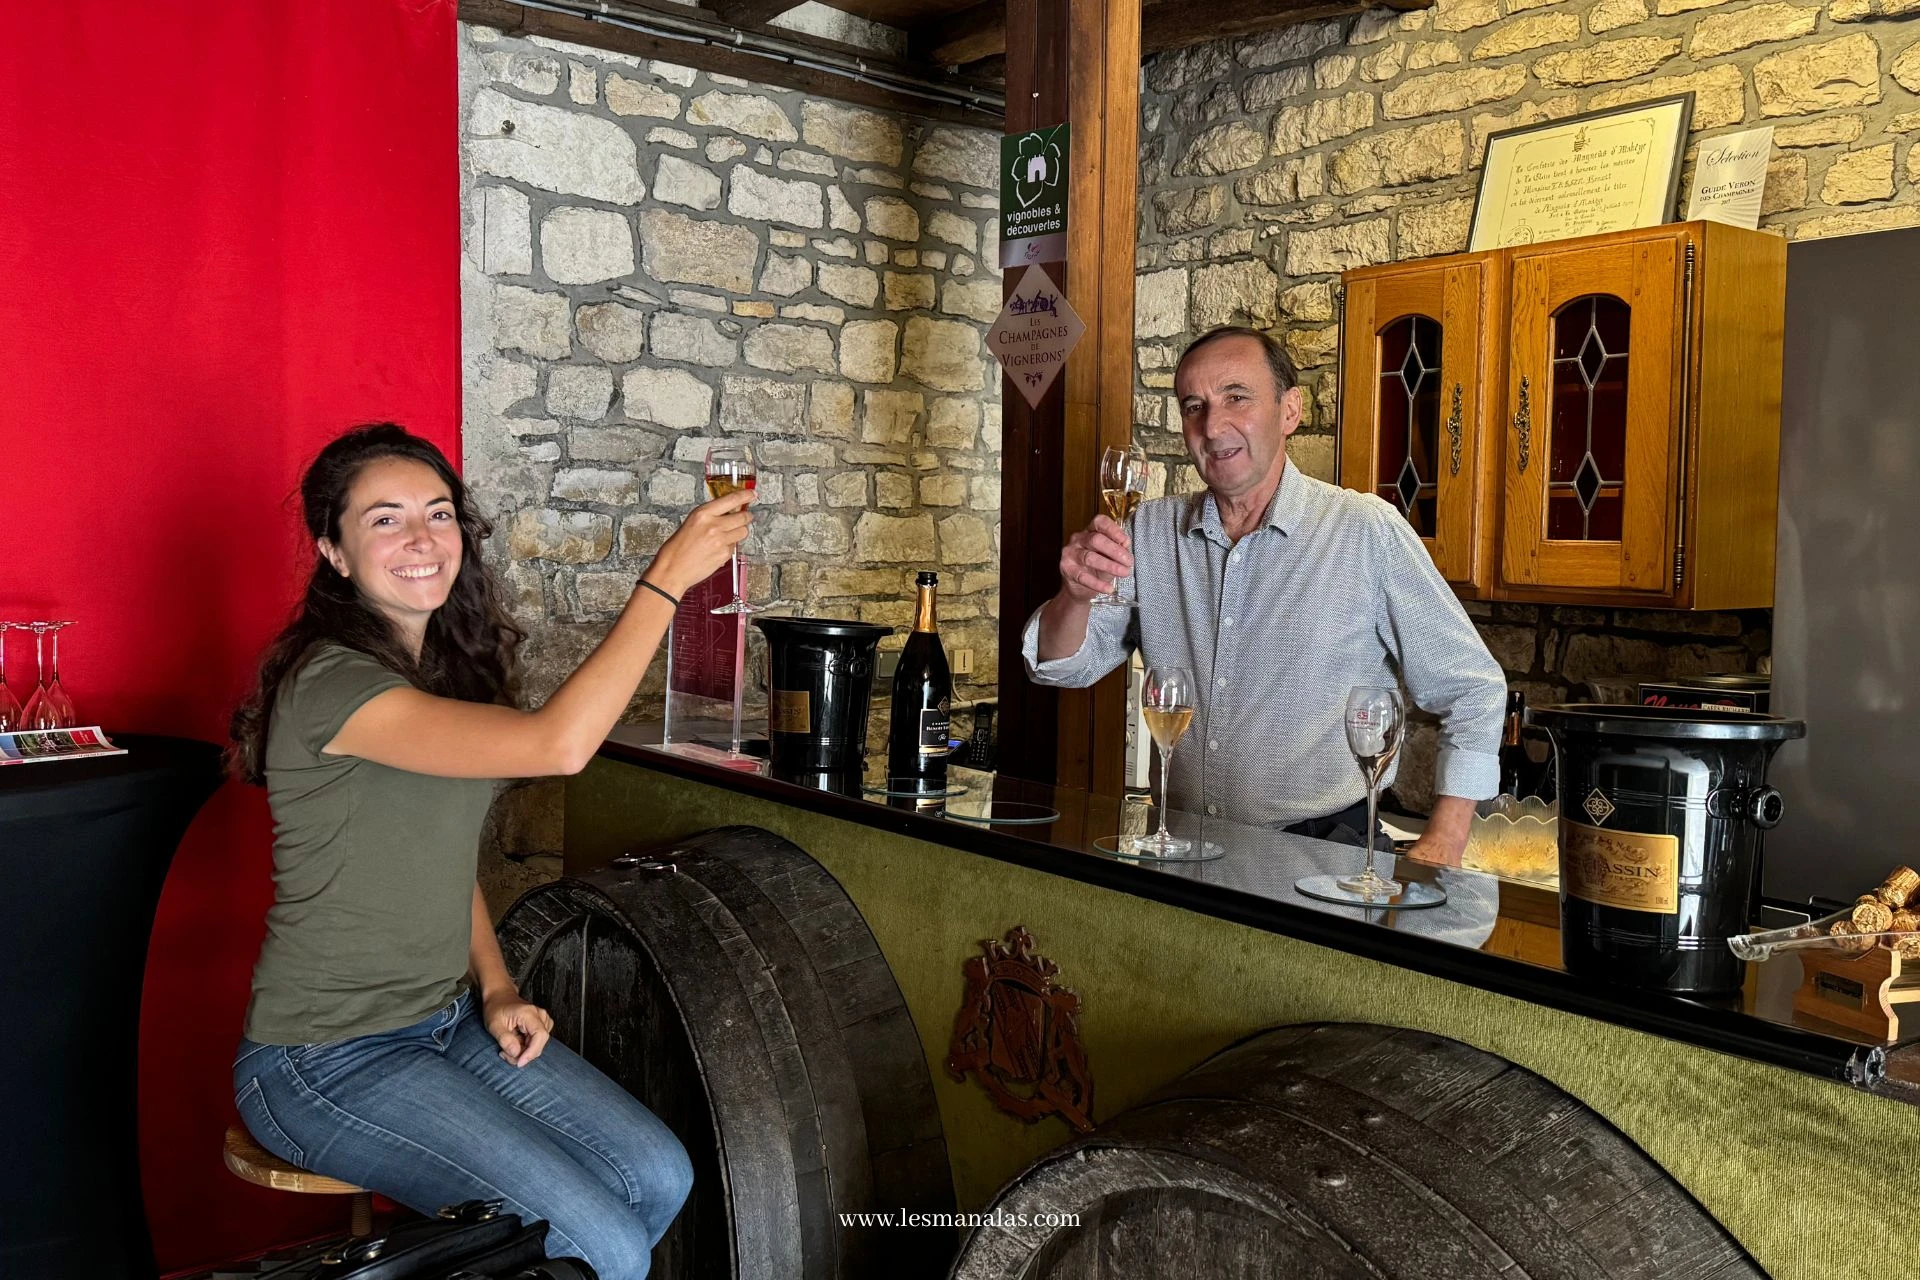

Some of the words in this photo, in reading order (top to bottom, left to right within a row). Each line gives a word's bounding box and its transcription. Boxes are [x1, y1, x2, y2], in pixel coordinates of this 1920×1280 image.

[1701, 185, 1726, 195] GUIDE
[1728, 179, 1756, 189] VERON
[1007, 207, 1052, 224] vignobles
[1054, 203, 1061, 215] &
[1006, 219, 1061, 236] découvertes
[999, 325, 1068, 345] CHAMPAGNES
